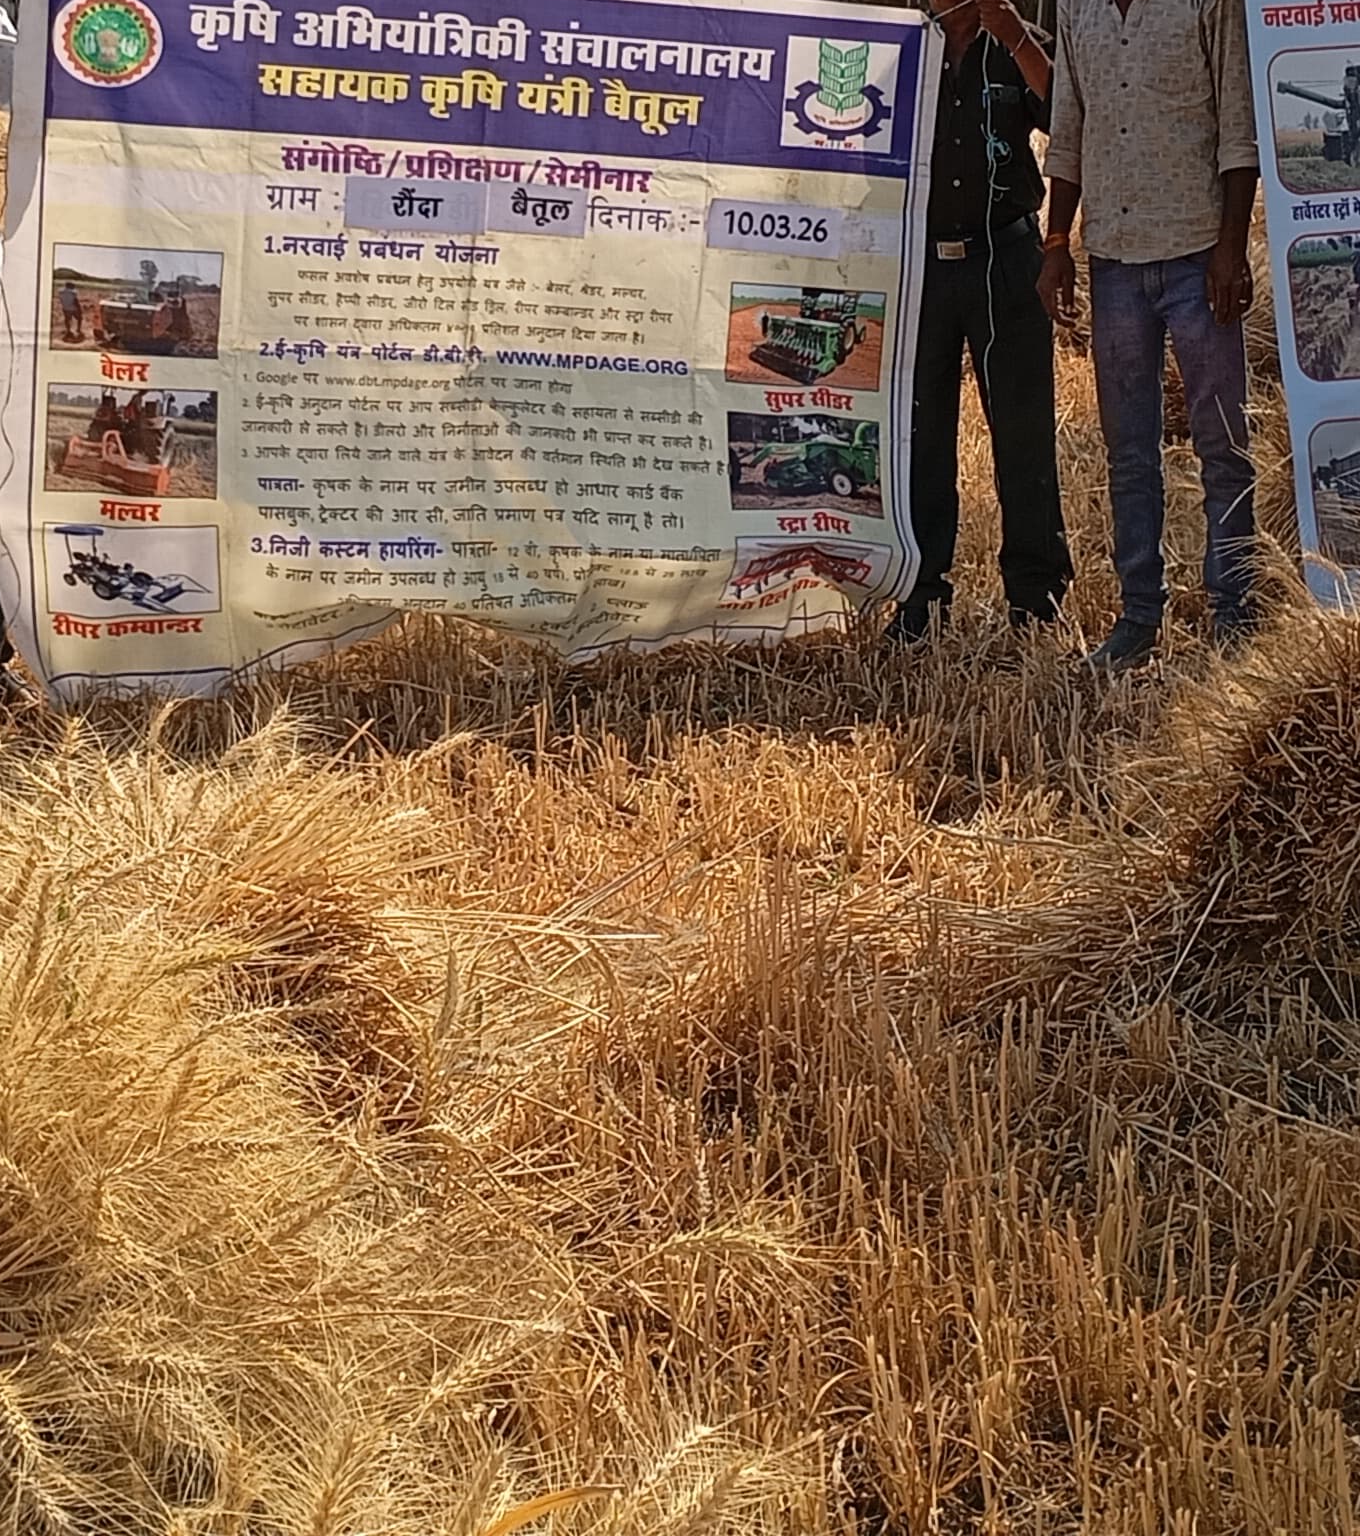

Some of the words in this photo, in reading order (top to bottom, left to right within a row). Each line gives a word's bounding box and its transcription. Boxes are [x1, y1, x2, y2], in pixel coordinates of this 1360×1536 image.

[293, 5, 531, 62] अभियांत्रिकी
[540, 21, 776, 82] संचालनालय
[258, 64, 411, 103] सहायक
[420, 70, 508, 111] कृषि
[517, 74, 593, 117] यंत्री
[601, 78, 704, 136] बैतूल
[266, 185, 322, 211] ग्राम
[391, 188, 443, 218] रौंदा
[511, 187, 573, 226] बैतूल
[587, 196, 672, 233] दिनांक
[724, 209, 828, 243] 10.03.26
[359, 236, 424, 261] प्रबंधन
[435, 241, 500, 265] योजना
[100, 353, 151, 383] बेलर
[337, 340, 362, 360] यंत्र
[372, 343, 414, 361] पोर्टल
[496, 350, 688, 376] WWW.MPDAGE.ORG
[256, 371, 298, 384] Google
[304, 372, 319, 386] पर
[300, 396, 342, 415] अनुदान
[349, 397, 381, 412] पोर्टल
[386, 400, 402, 412] पर
[764, 390, 805, 412] सुपर
[810, 388, 854, 411] सीडर
[241, 419, 292, 434] जानकारी
[412, 425, 435, 438] और
[528, 425, 576, 442] जानकारी
[257, 476, 304, 492] पात्रता-
[312, 478, 352, 498] कृषक
[359, 476, 373, 493] के
[380, 480, 409, 494] नाम
[417, 480, 436, 495] पर
[444, 476, 486, 494] जमीन
[493, 480, 548, 493] उपलब्ध
[555, 478, 568, 496] हो
[576, 483, 620, 498] आधार
[626, 483, 654, 501] कार्ड
[659, 485, 684, 501] बैंक
[99, 499, 162, 522] मल्चर
[366, 505, 384, 521] की
[392, 509, 418, 523] आर
[452, 503, 488, 523] जाति
[494, 508, 536, 522] प्रमाण
[544, 509, 565, 523] पत्र
[572, 508, 600, 525] यदि
[607, 512, 639, 532] लागू
[644, 512, 654, 529] है
[776, 516, 808, 534] स्ट्रा
[813, 512, 852, 534] रीपर
[251, 535, 310, 557] 3.निजी
[319, 541, 371, 558] कस्टम
[379, 537, 444, 561] हायरिंग-
[548, 545, 583, 567] कृषक
[266, 564, 279, 579] के
[285, 568, 313, 583] नाम
[320, 571, 338, 585] पर
[344, 568, 383, 586] जमीन
[389, 571, 436, 586] उपलब्ध
[443, 568, 456, 588] हो
[52, 615, 100, 638] रीपर
